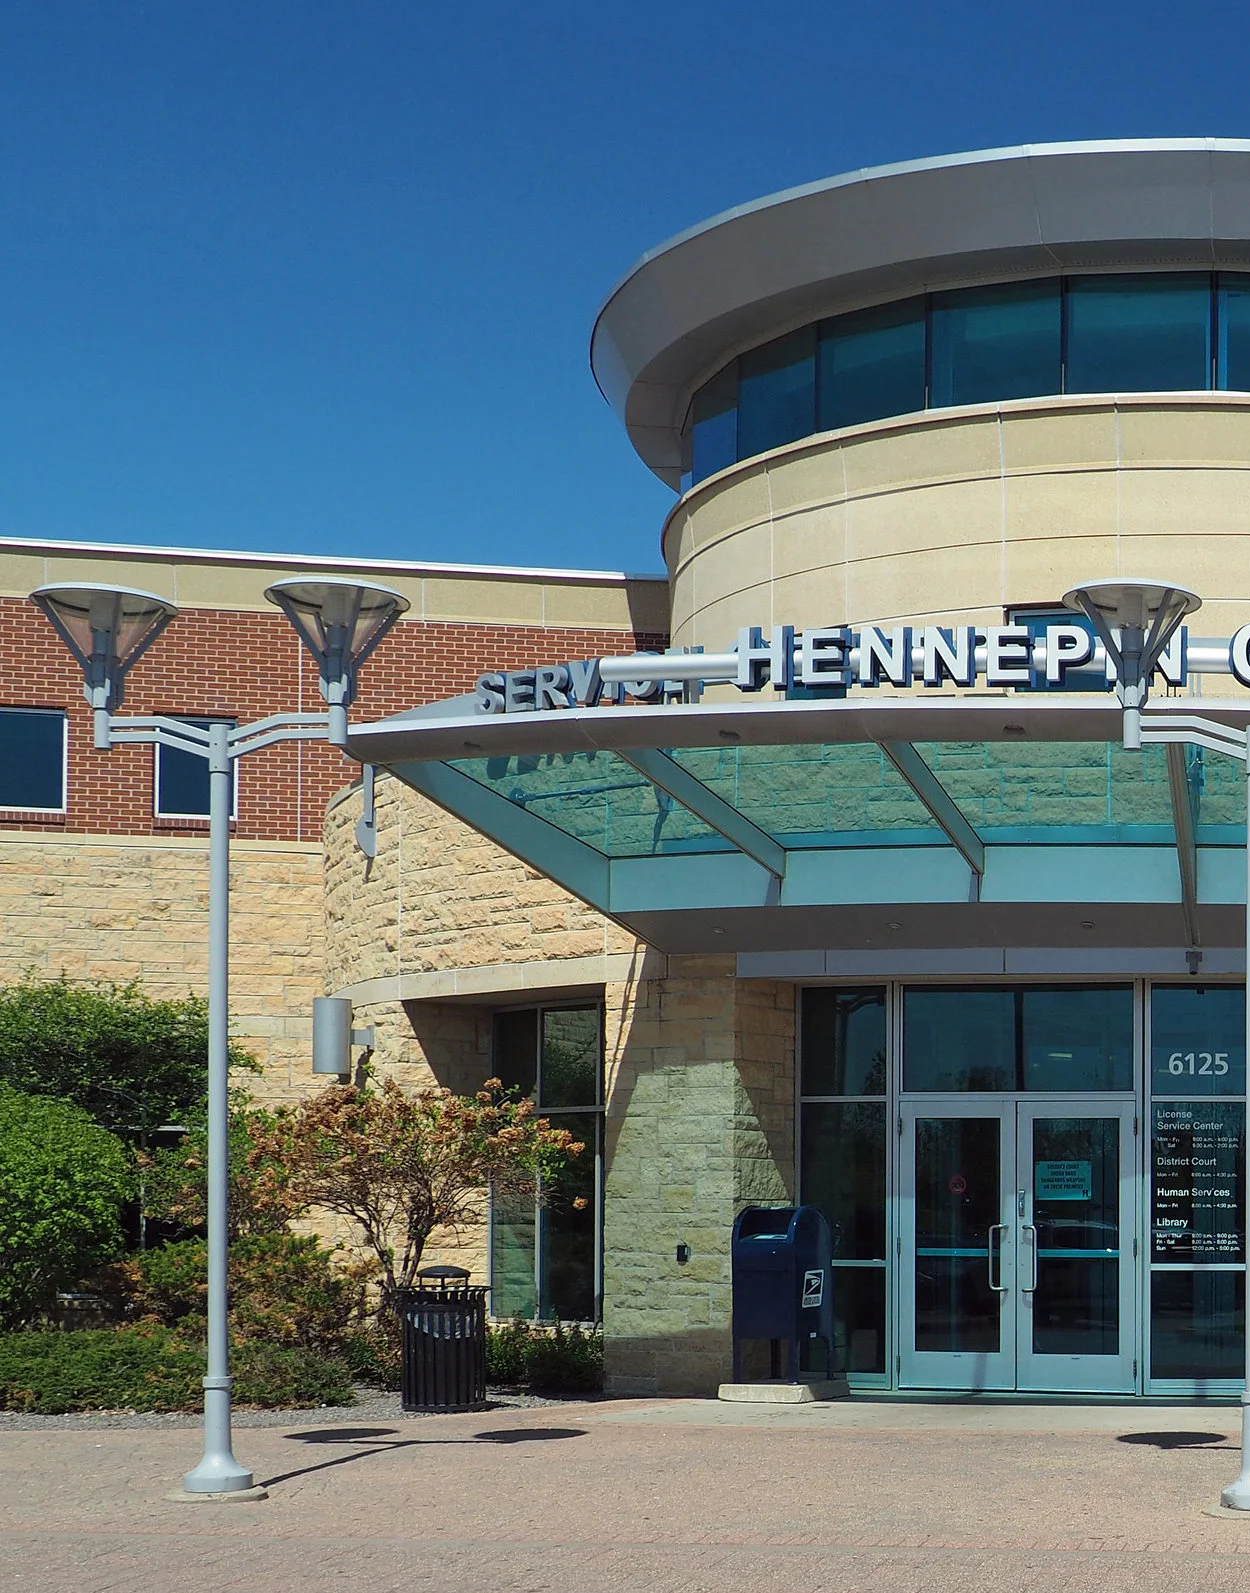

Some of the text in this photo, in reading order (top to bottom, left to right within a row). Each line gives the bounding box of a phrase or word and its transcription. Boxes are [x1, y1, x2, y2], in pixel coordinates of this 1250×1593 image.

[1168, 1052, 1229, 1075] 6125
[1157, 1110, 1192, 1119] License
[1157, 1121, 1224, 1130] Service Center
[1157, 1157, 1217, 1166] District Court
[1157, 1187, 1189, 1197] Human
[1156, 1218, 1188, 1228] Library
